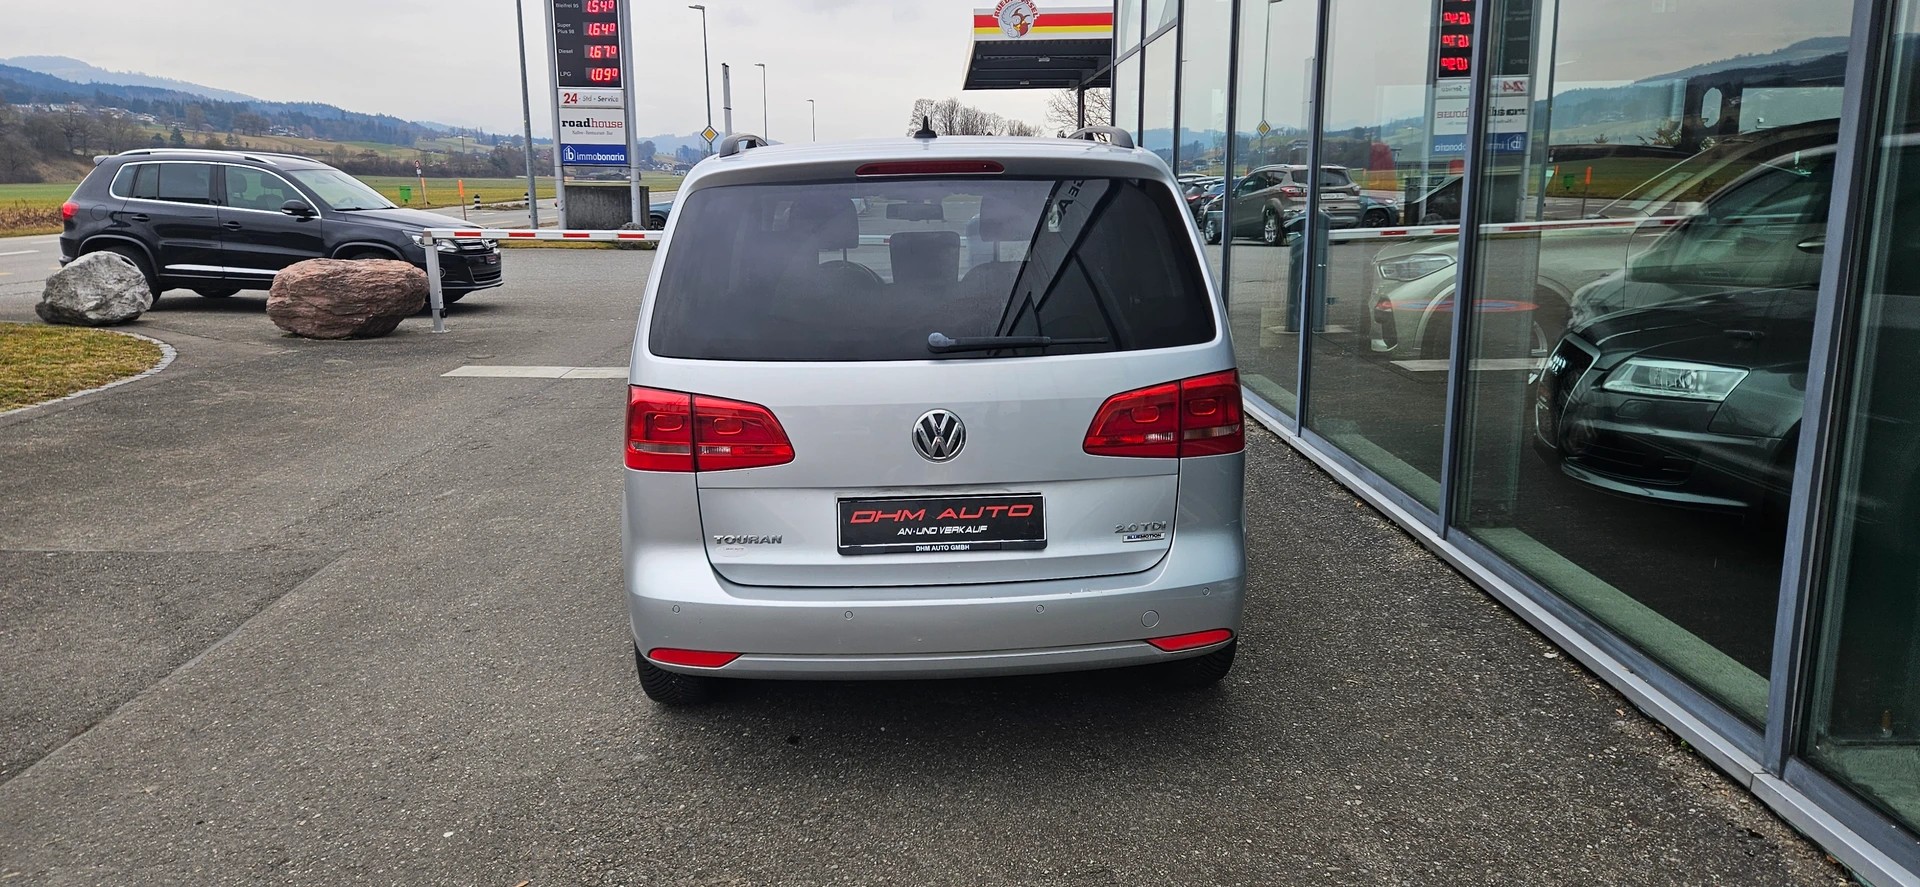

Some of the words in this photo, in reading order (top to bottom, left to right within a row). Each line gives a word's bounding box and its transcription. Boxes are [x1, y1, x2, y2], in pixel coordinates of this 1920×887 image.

[563, 92, 578, 104] 24
[562, 118, 623, 128] roadhouse
[577, 153, 625, 161] immobonaria
[850, 509, 926, 524] DHM
[936, 504, 1034, 520] AUTO
[939, 525, 988, 534] VERKAUF
[1140, 521, 1167, 531] TDI
[713, 534, 783, 544] TOURAN
